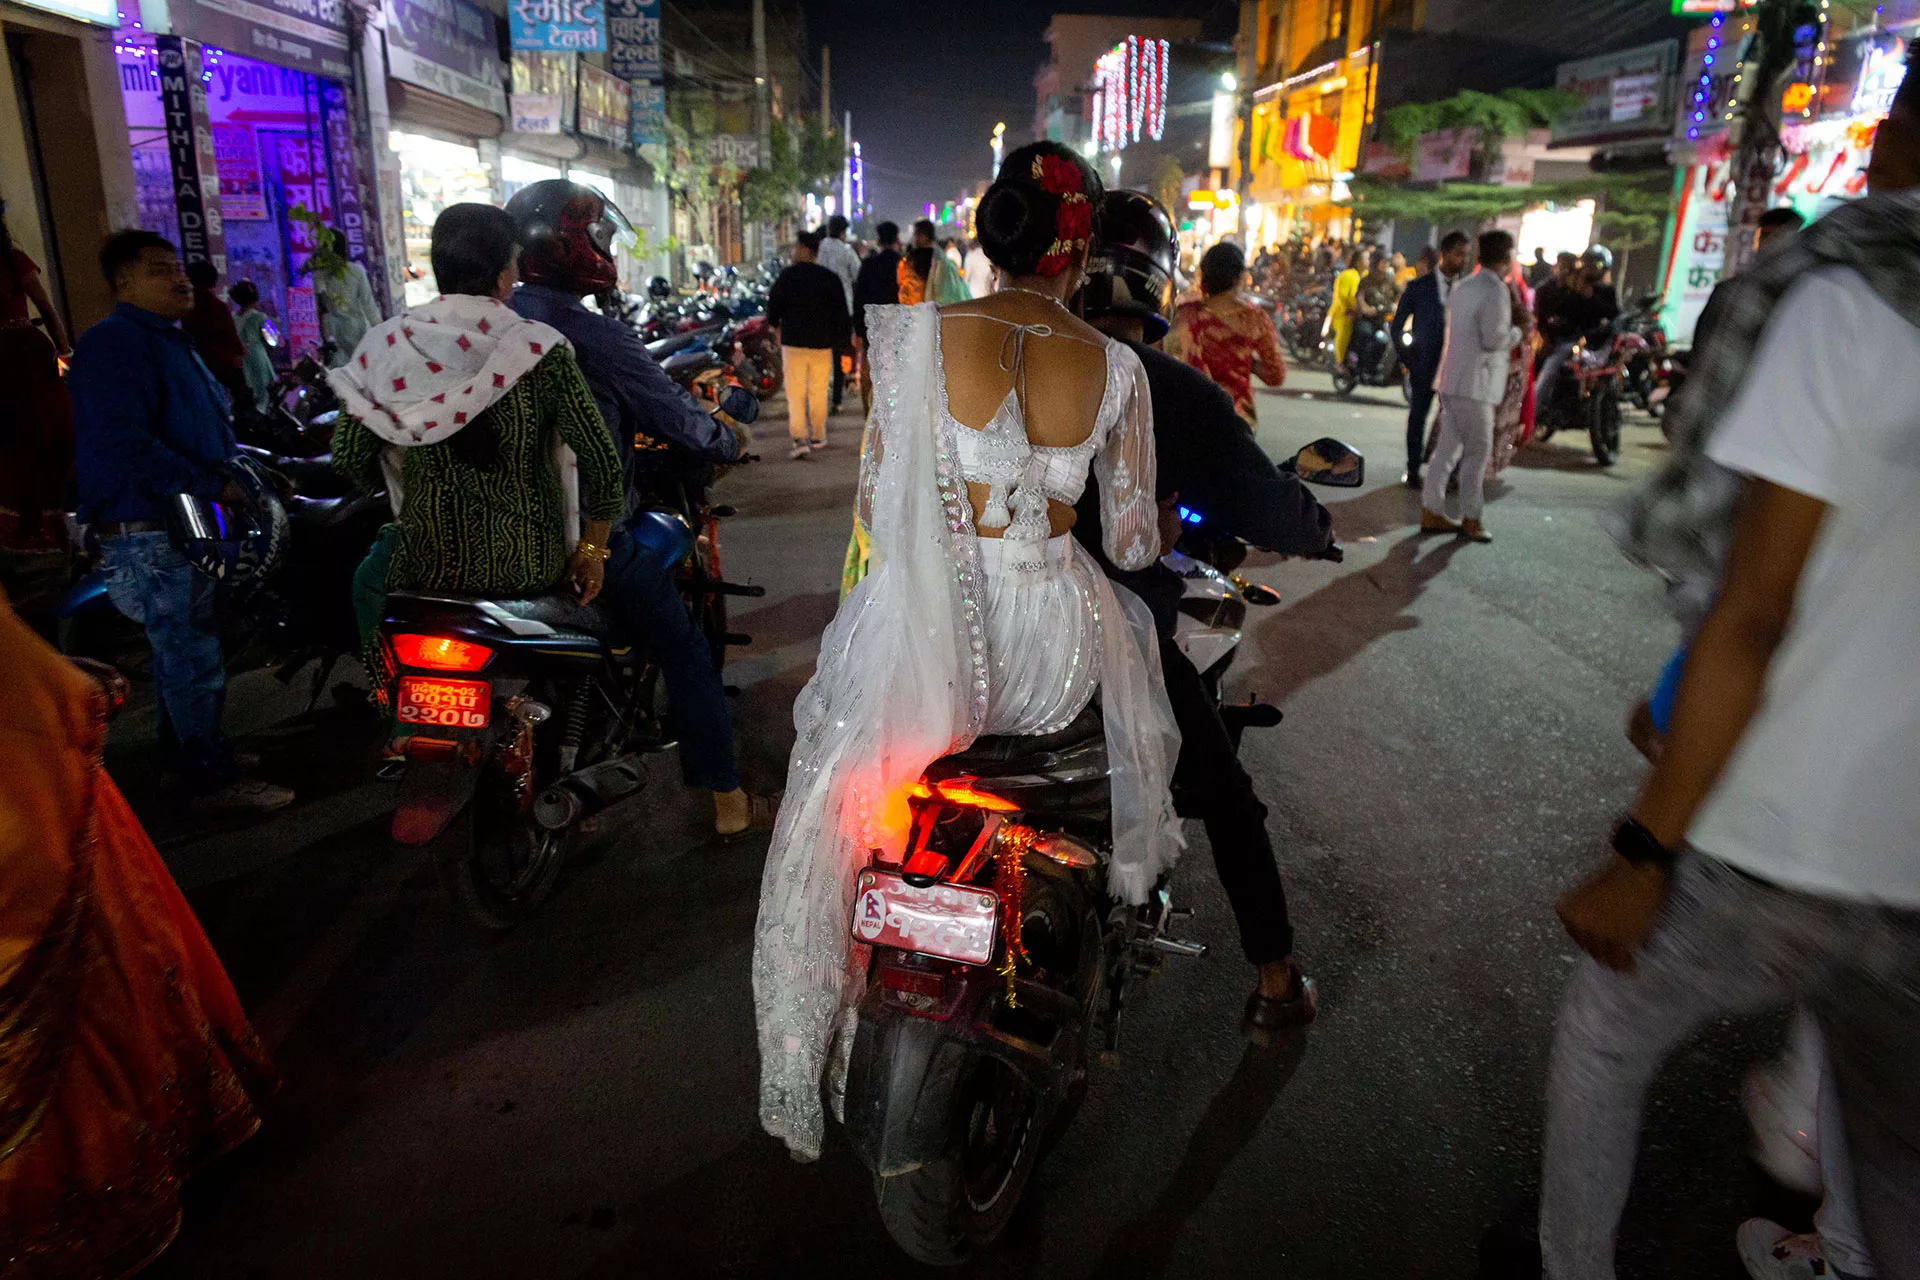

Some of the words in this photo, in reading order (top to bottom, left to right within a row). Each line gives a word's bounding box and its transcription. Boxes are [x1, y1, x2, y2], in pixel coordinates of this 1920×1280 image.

[163, 76, 198, 198] MITHILA
[328, 108, 358, 203] MITHILA
[344, 212, 367, 262] DEP
[401, 705, 485, 727] २२०७
[861, 919, 882, 931] NEPAL
